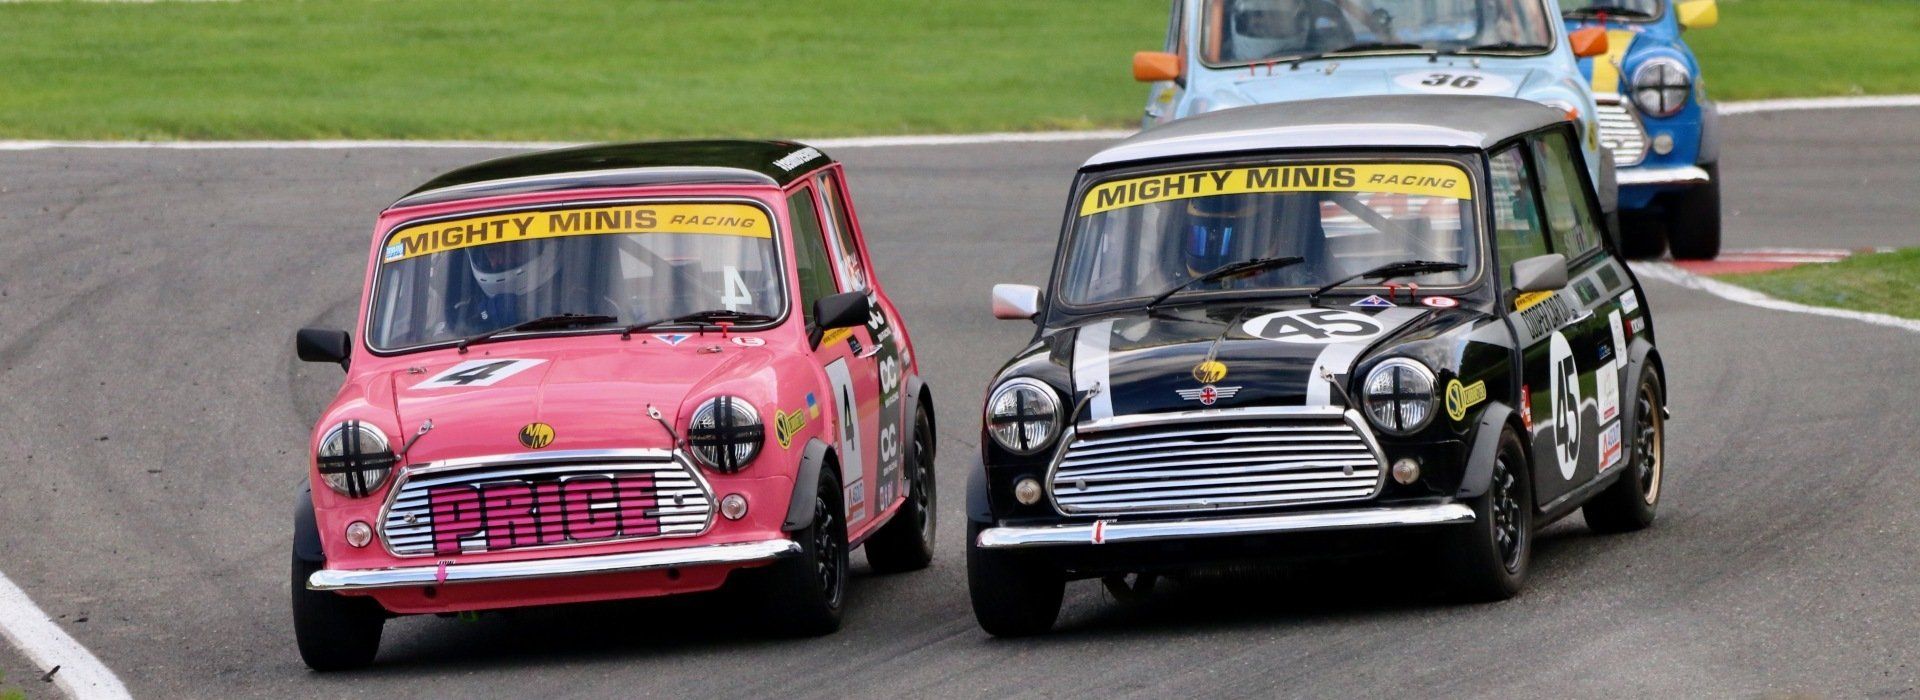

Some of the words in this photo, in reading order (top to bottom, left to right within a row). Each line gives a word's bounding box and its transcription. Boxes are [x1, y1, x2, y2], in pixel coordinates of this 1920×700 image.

[1421, 74, 1484, 89] 36
[1096, 170, 1233, 209] MIGHTY
[1245, 167, 1355, 190] MINIS
[1368, 173, 1457, 189] RACING
[403, 216, 535, 254] MIGHTY
[549, 210, 657, 233] MINIS
[670, 215, 755, 228] RACING
[1260, 311, 1380, 340] 45
[434, 360, 520, 386] 4
[843, 384, 855, 451] 4
[1556, 355, 1579, 464] 45
[428, 472, 661, 556] PRICE
